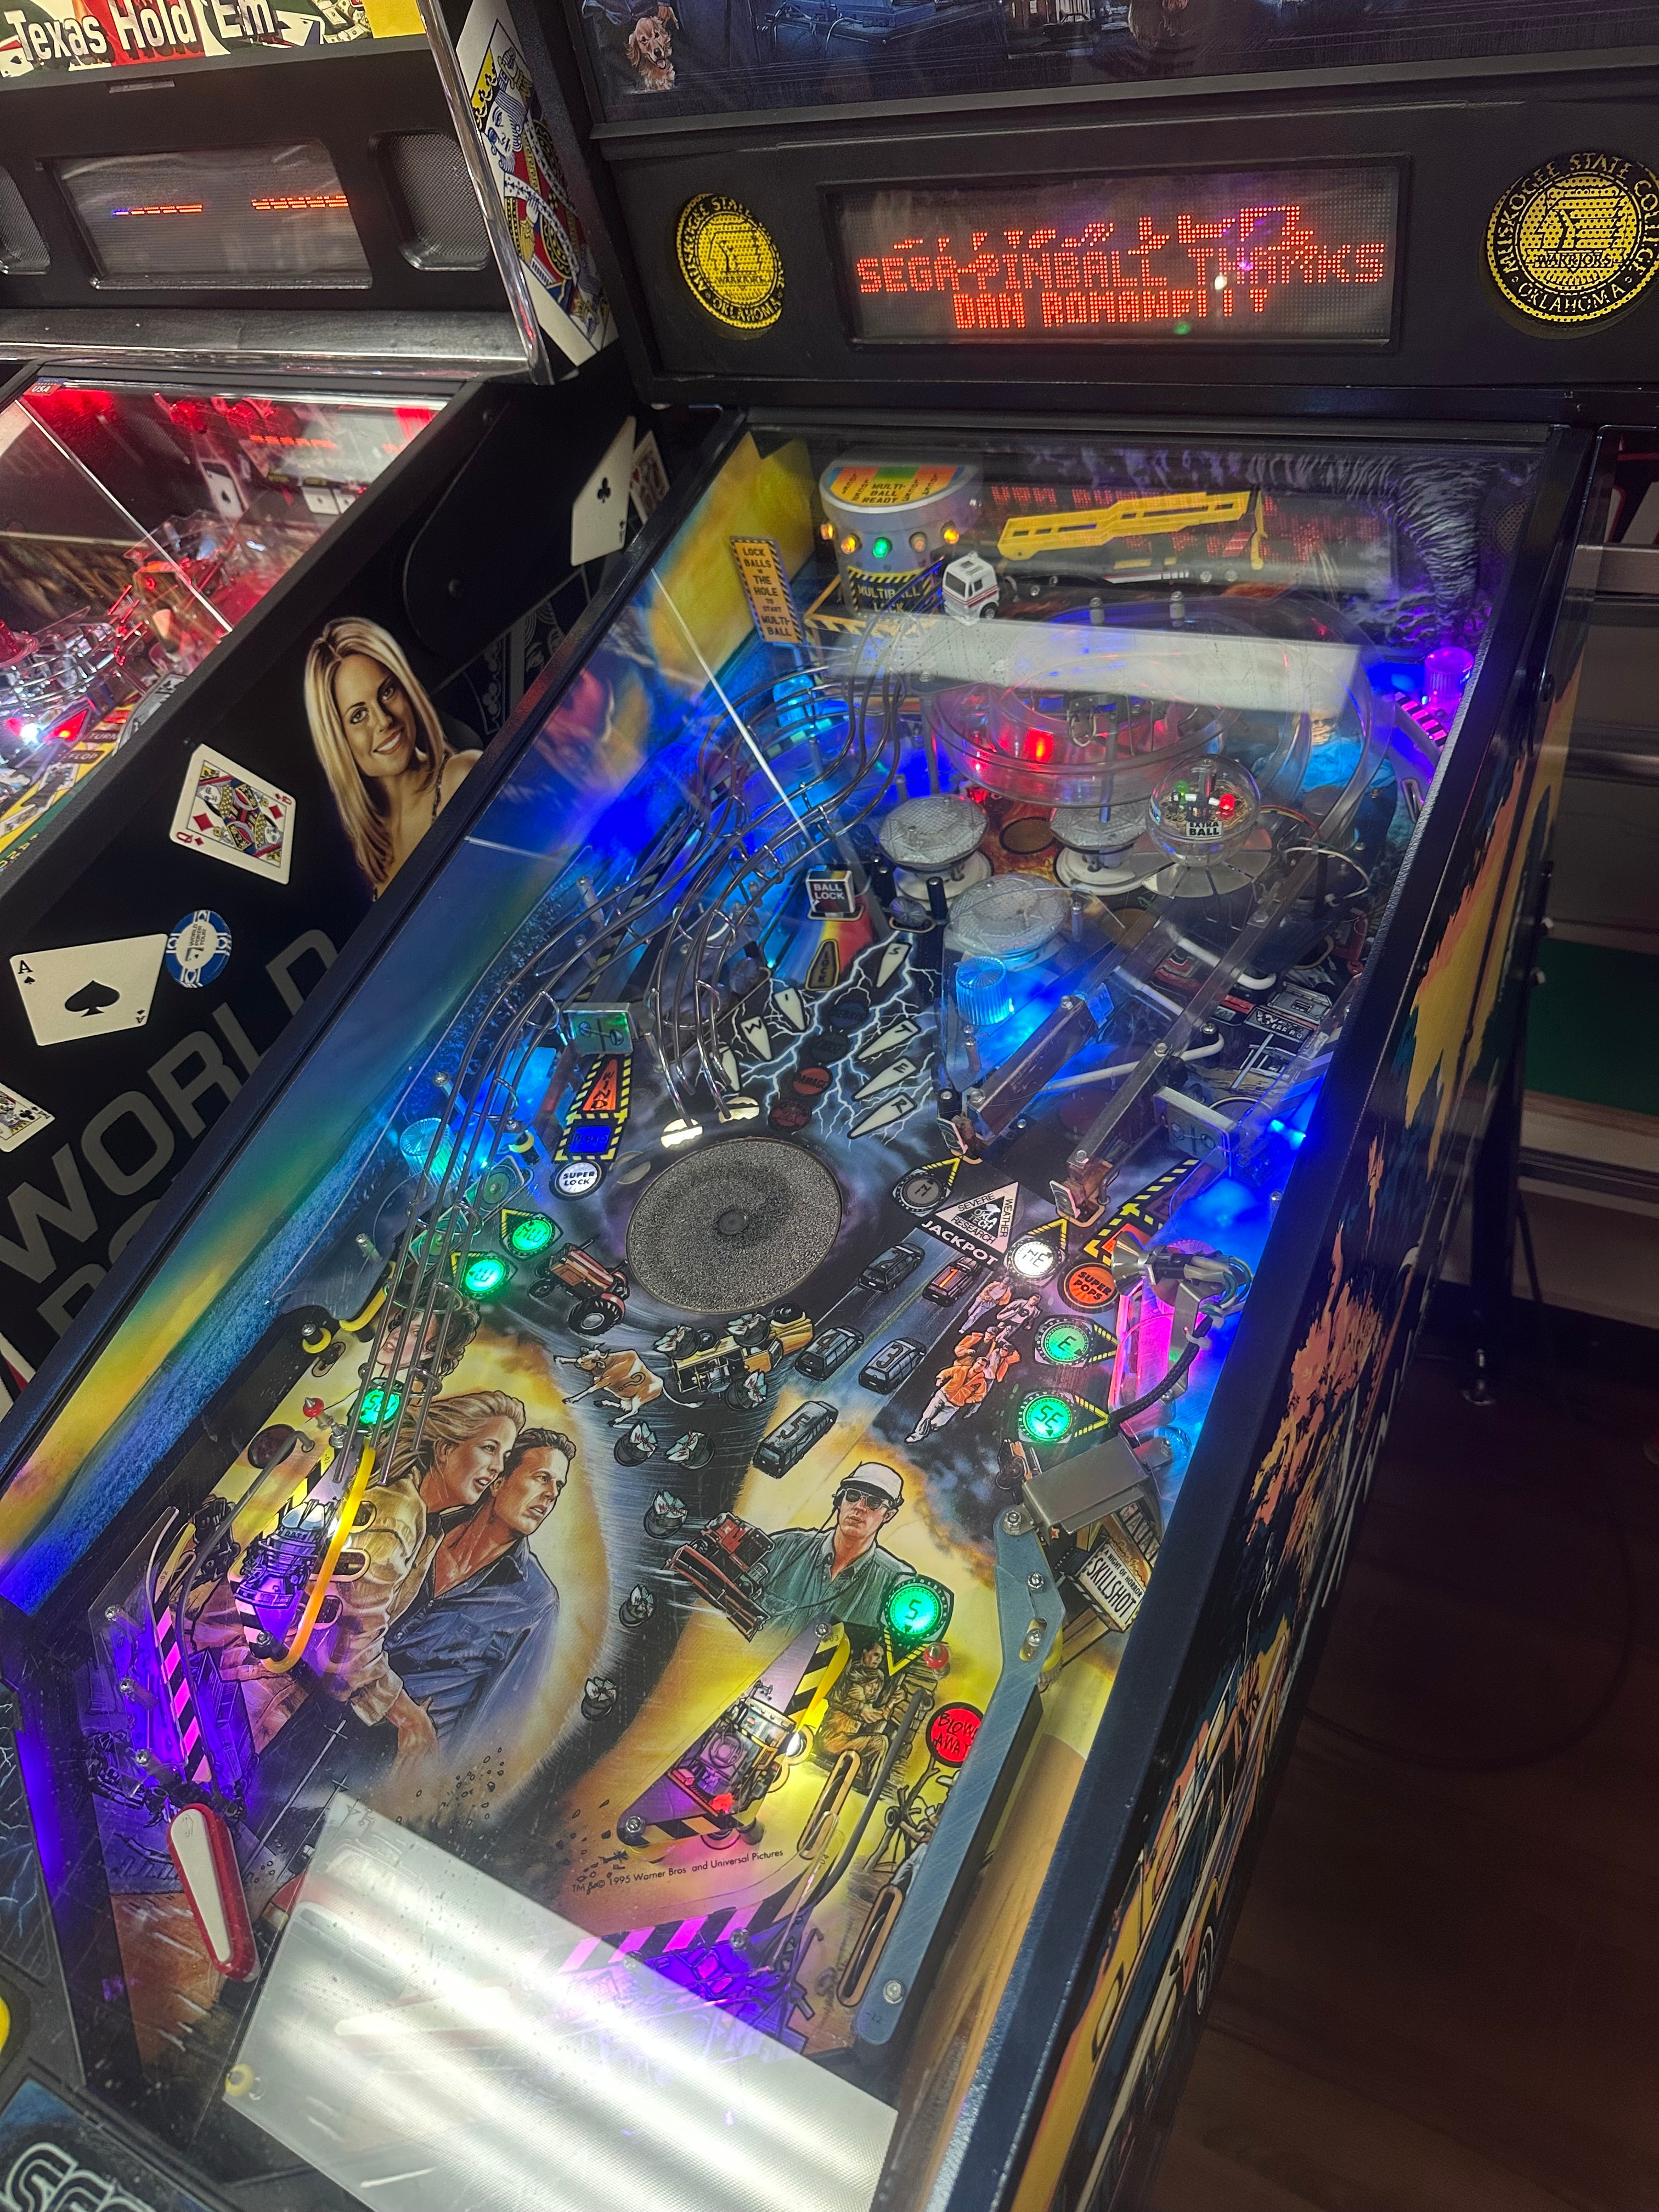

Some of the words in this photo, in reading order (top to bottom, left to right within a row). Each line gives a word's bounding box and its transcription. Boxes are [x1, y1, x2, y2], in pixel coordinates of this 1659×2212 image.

[4, 9, 108, 62] Texas
[109, 0, 197, 50] Hold
[1498, 161, 1560, 274] MUSKOGEE
[1570, 153, 1633, 180] STATE
[856, 254, 960, 293] SEGA
[1188, 242, 1385, 284] THANKS
[1536, 253, 1614, 267] WARRIORS
[715, 275, 766, 284] WARRIORS
[1518, 282, 1626, 313] OKLAHOMA
[712, 298, 782, 321] OKLAHOMA
[952, 292, 1025, 329] DAN
[742, 548, 765, 557] LOCK
[744, 559, 771, 568] BALLS
[753, 575, 772, 585] THE
[753, 587, 778, 596] HOLE
[857, 584, 920, 599] MULTIBLL
[766, 628, 792, 636] BALL
[176, 832, 193, 844] Q
[814, 883, 843, 892] BALL
[814, 892, 845, 901] LOCK
[189, 924, 198, 946] WORLD
[17, 960, 33, 974] A
[745, 1023, 762, 1033] W
[896, 1025, 912, 1034] T
[894, 1064, 907, 1074] E
[591, 1071, 614, 1109] WIND
[793, 1074, 828, 1088] DAMAGE
[0, 929, 339, 1284] WORLD
[891, 1101, 907, 1113] R
[957, 1193, 995, 1211] SEVERE
[969, 1214, 994, 1231] TECH
[974, 1209, 998, 1225] OKLA
[1000, 1198, 1013, 1238] WEATHER
[951, 1216, 996, 1244] RESEARCH
[921, 1220, 998, 1266] JACKPOT
[1023, 1249, 1045, 1268] NE
[939, 1267, 960, 1288] 1
[1078, 1271, 1112, 1295] SUPER
[1074, 1279, 1103, 1300] POPS
[816, 1332, 840, 1355] 4
[1058, 1335, 1076, 1351] E
[876, 1344, 904, 1368] 3
[779, 1412, 811, 1441] 5
[1034, 1406, 1062, 1429] SE
[1107, 1553, 1122, 1571] NIGHT
[1119, 1567, 1127, 1577] OF
[1125, 1575, 1143, 1598] HORROR
[1087, 1558, 1136, 1618] SKILLSHOT
[909, 1599, 922, 1620] S
[938, 1713, 978, 1737] BLOW
[572, 1883, 585, 1892] TM
[609, 1875, 631, 1886] 1995
[634, 1870, 665, 1881] Warner
[668, 1866, 686, 1876] Bros
[692, 1861, 708, 1872] and
[710, 1854, 749, 1869] Universal
[752, 1849, 783, 1860] Pictures
